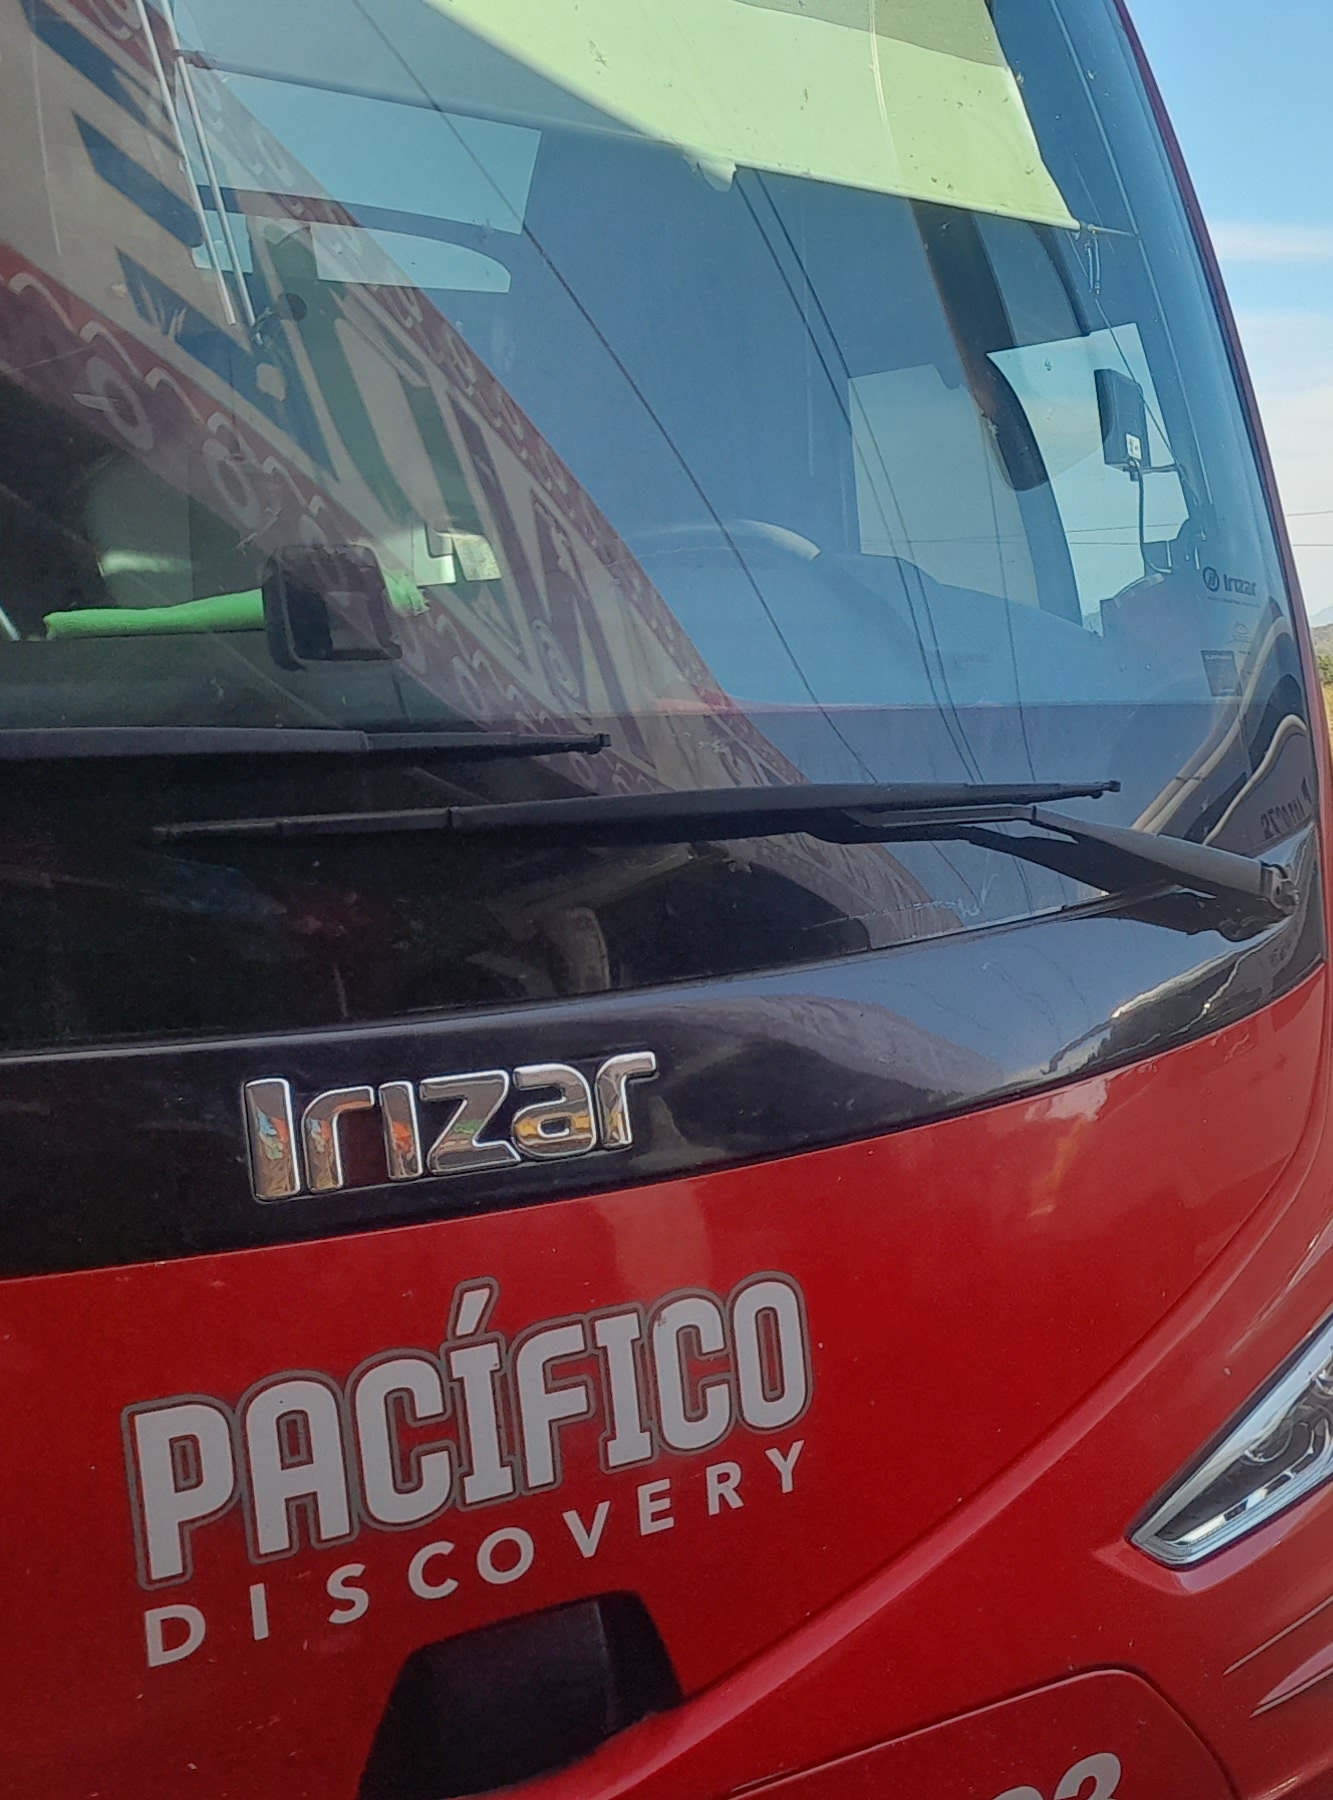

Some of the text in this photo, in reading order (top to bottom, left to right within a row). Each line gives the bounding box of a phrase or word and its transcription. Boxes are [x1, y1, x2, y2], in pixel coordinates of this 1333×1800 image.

[242, 1049, 658, 1202] Irizar
[124, 1272, 813, 1588] PACÍFICO
[143, 1439, 805, 1668] DISCOVERY
